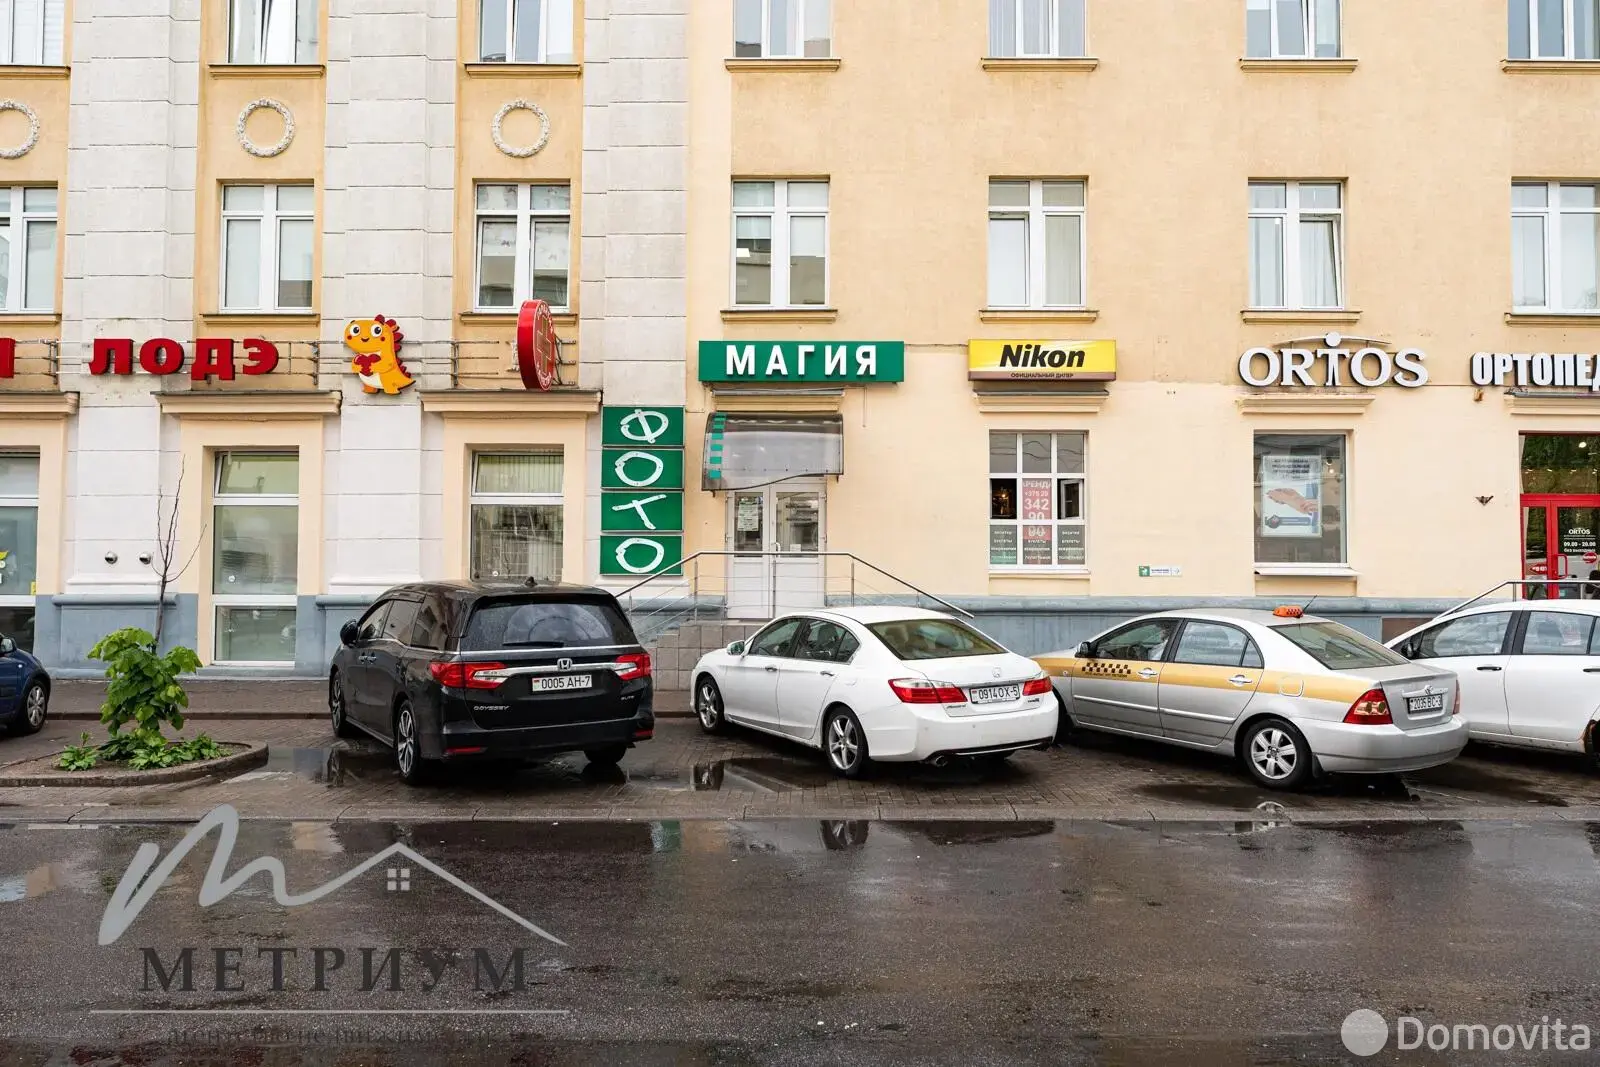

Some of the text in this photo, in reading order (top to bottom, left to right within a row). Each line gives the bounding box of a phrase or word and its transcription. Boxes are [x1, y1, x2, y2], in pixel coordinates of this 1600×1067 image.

[89, 337, 279, 381] ЛОДЭ
[726, 344, 879, 376] МАГИЯ
[1000, 344, 1085, 368] Nikon
[1239, 338, 1429, 388] ORTOS
[1024, 498, 1049, 510] 342
[541, 676, 590, 689] 0005 AH-7
[978, 689, 998, 700] 0914
